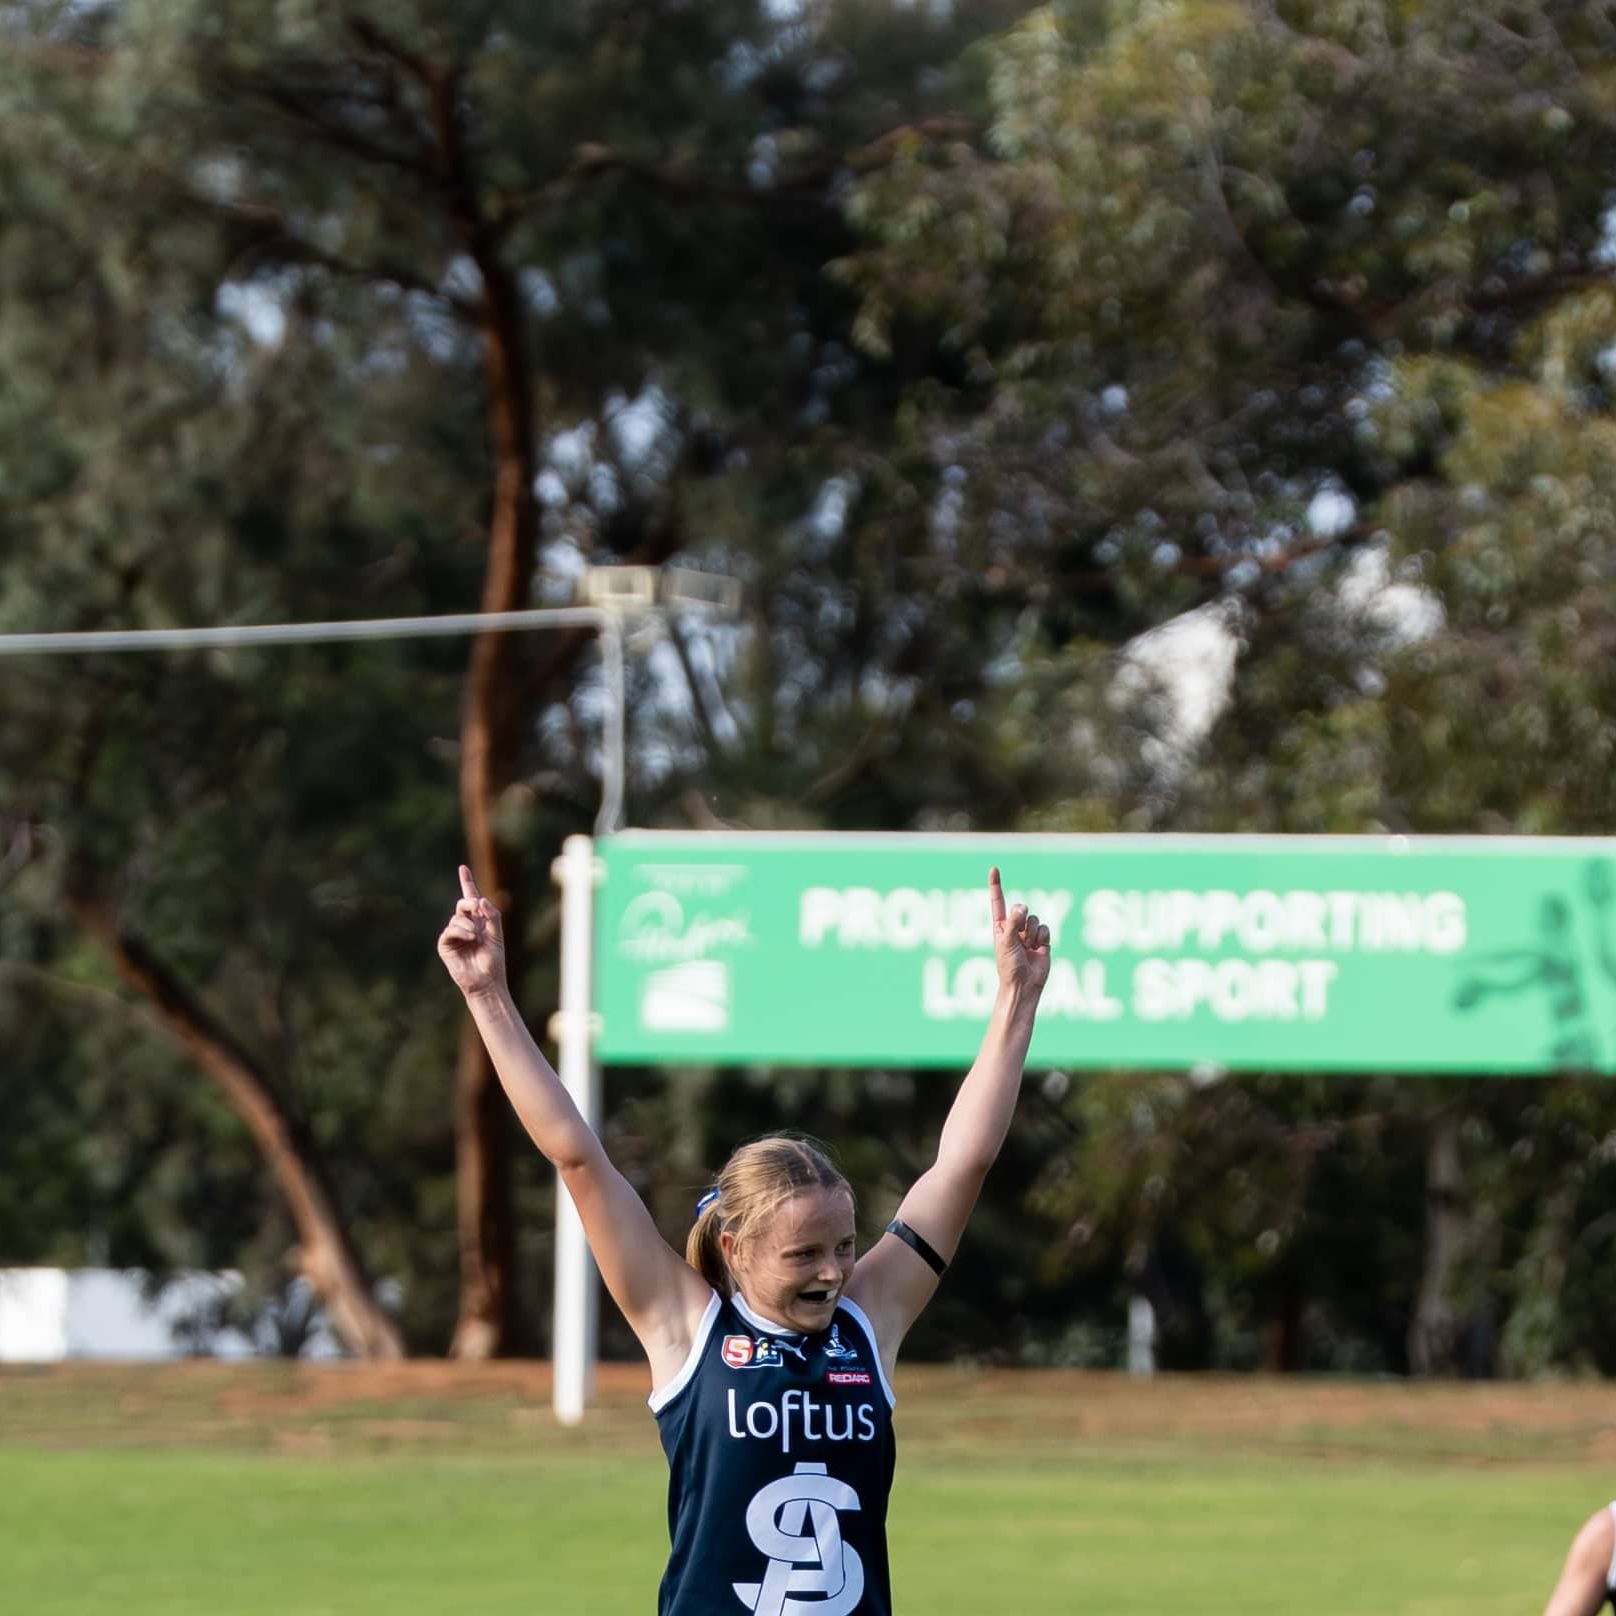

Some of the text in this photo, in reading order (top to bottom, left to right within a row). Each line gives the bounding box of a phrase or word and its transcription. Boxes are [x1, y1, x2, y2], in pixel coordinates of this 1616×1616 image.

[1082, 889, 1468, 953] SUPPORTING
[922, 956, 1338, 1022] LOAL SPORT
[728, 1389, 875, 1454] loftus
